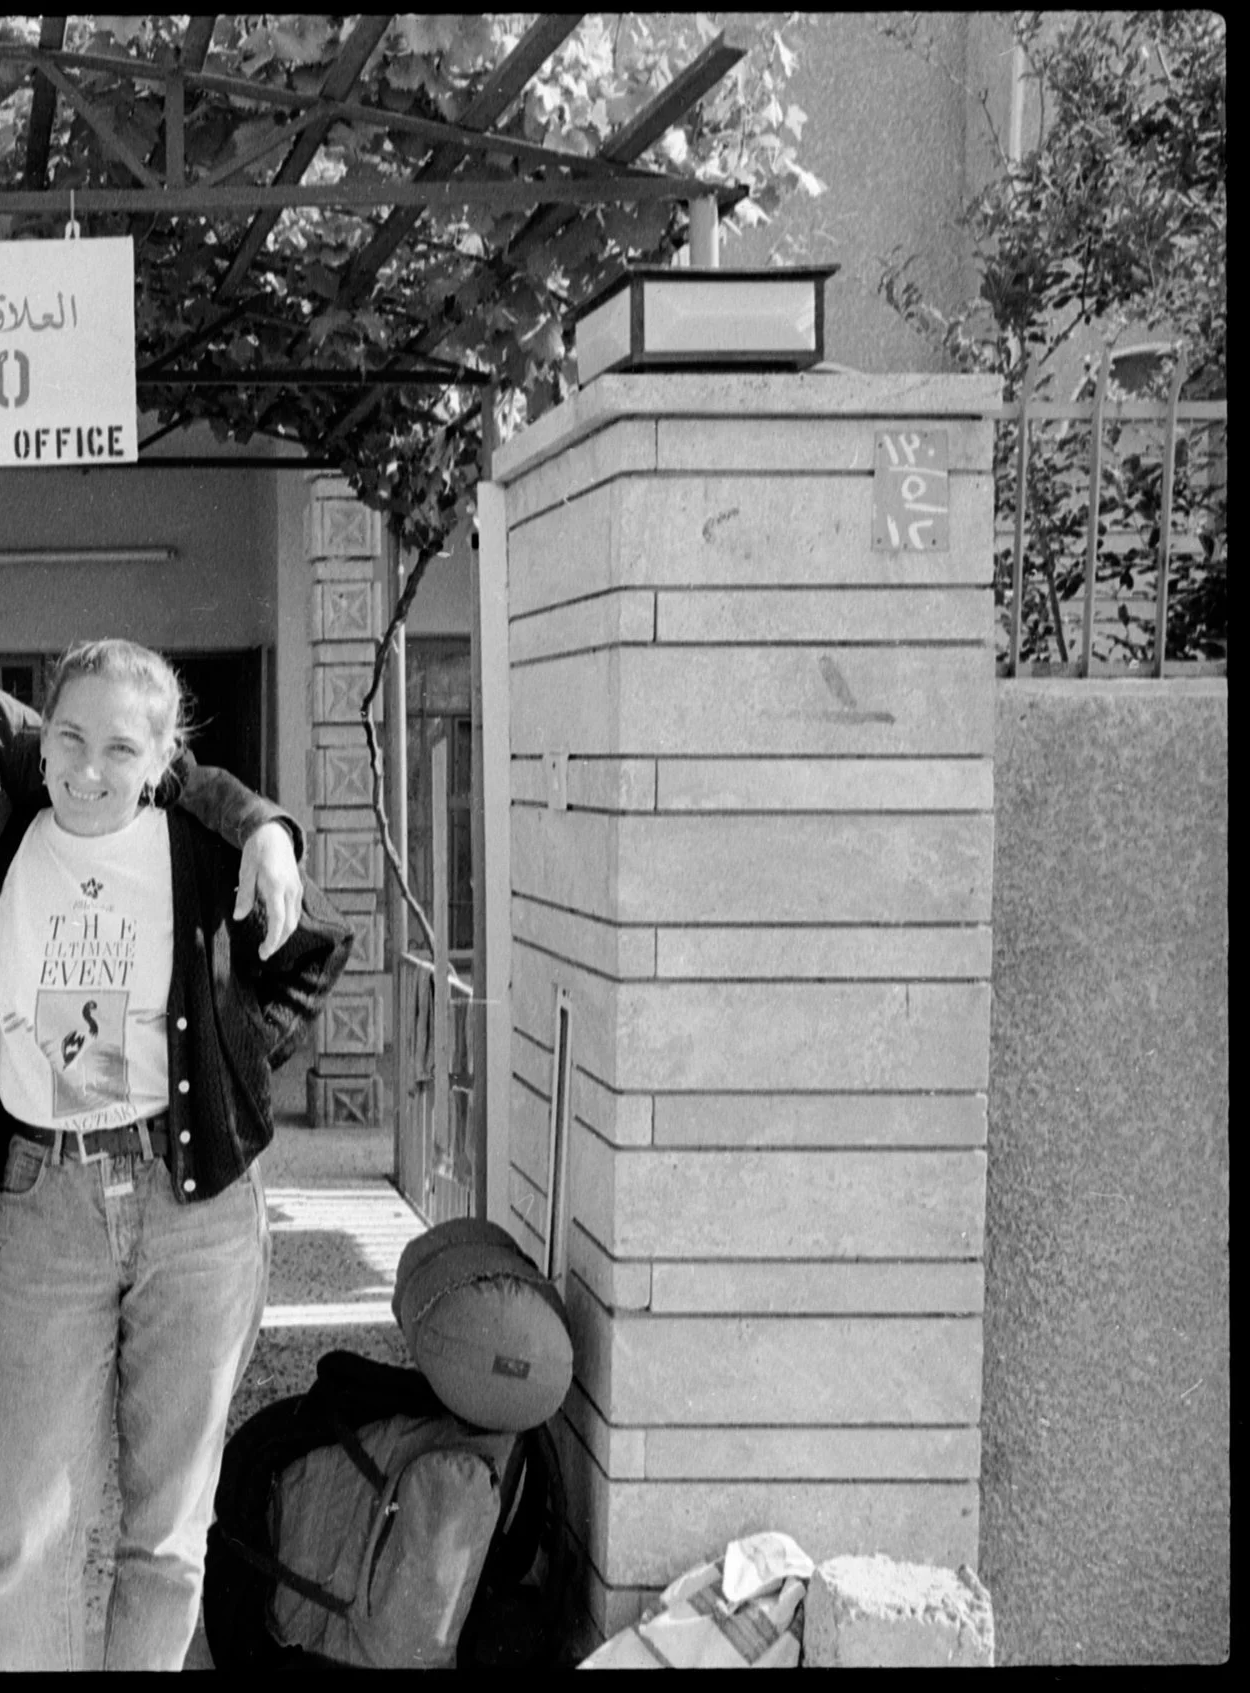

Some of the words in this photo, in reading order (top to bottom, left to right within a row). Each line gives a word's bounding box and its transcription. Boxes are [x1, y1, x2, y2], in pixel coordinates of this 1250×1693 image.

[14, 425, 125, 459] OFFICE
[44, 941, 135, 958] ULTIMATE
[40, 959, 134, 987] EVENT
